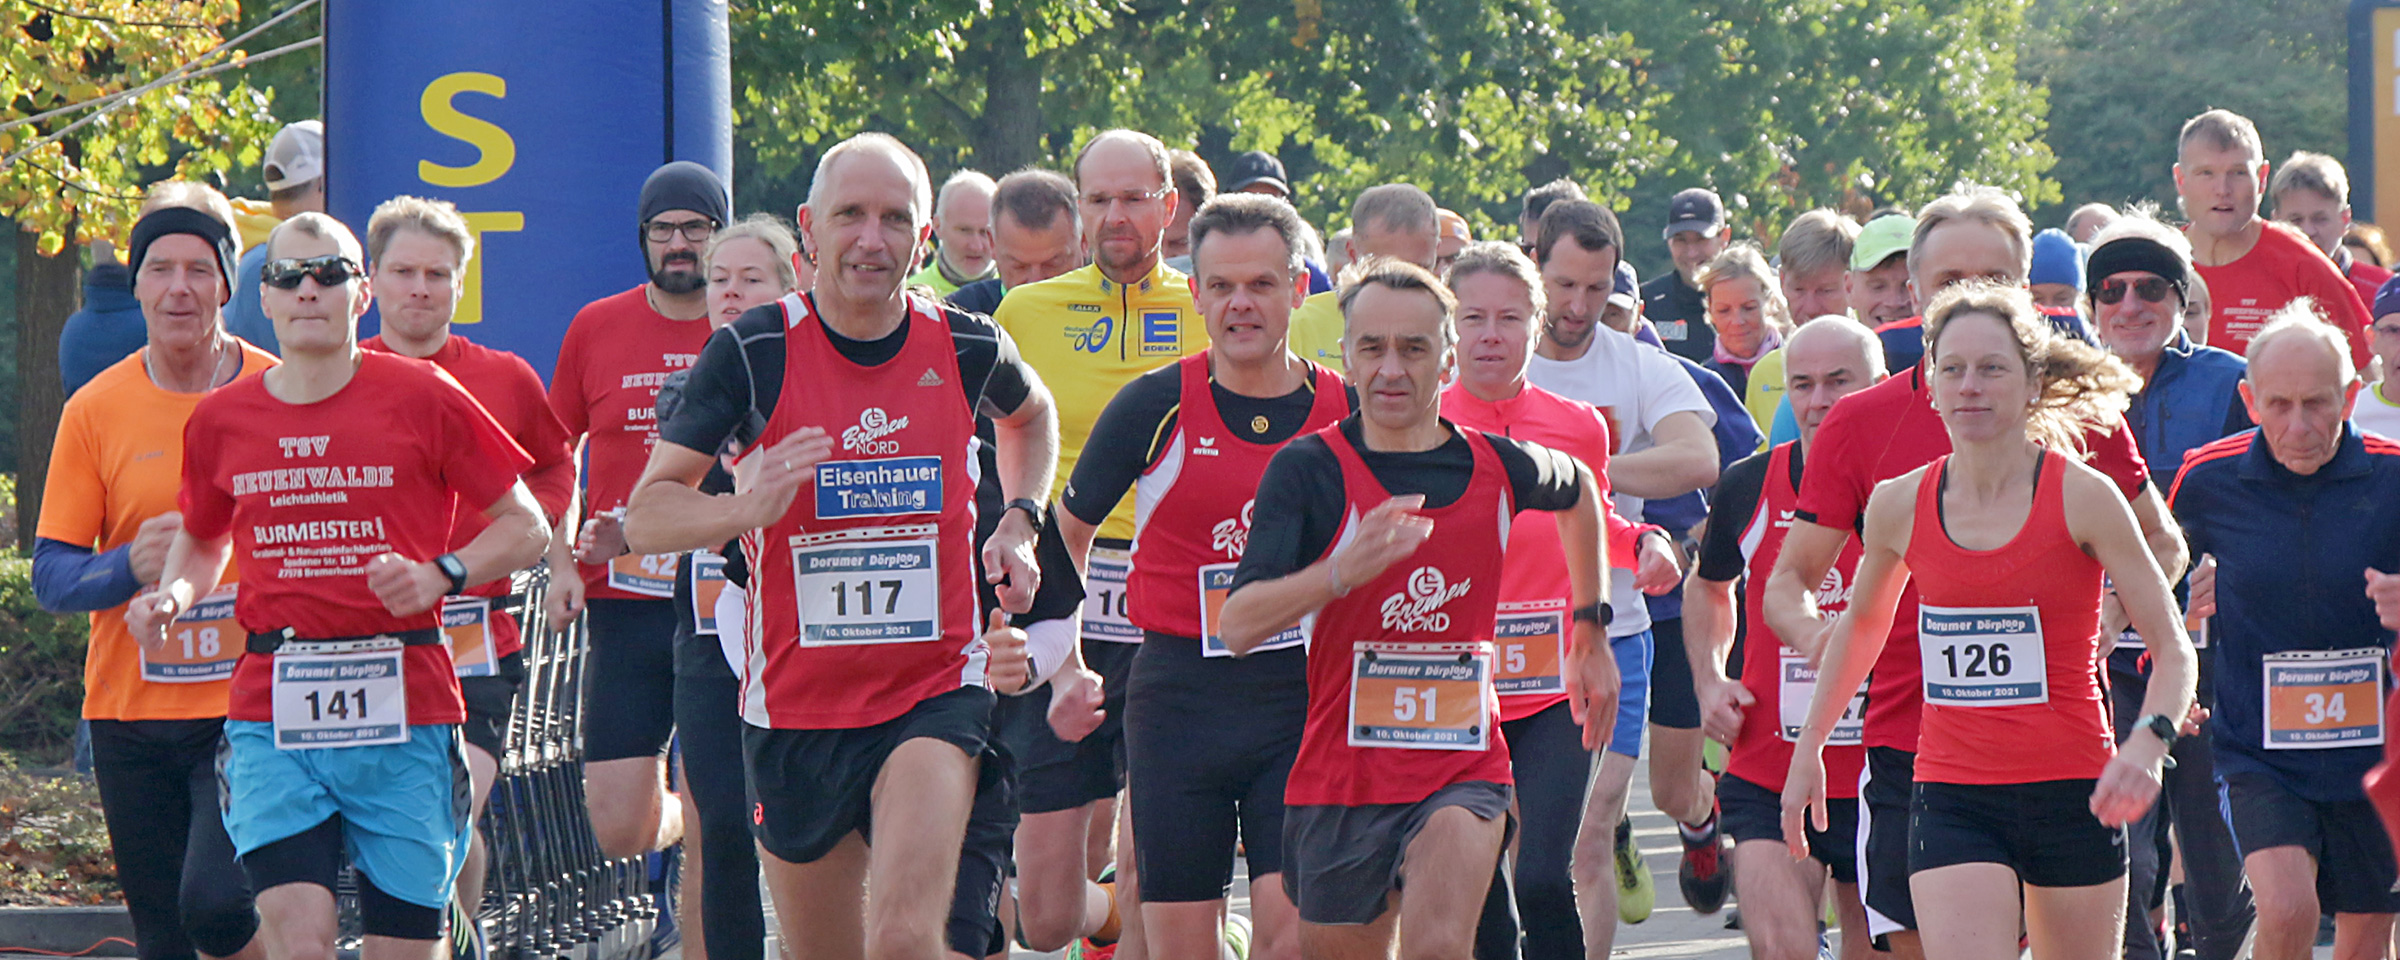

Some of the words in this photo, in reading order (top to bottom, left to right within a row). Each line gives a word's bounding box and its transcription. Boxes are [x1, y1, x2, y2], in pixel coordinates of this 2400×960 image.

[663, 353, 697, 367] TSV
[842, 416, 909, 450] Bremen
[279, 435, 330, 458] TSV
[856, 441, 899, 455] NORD
[232, 466, 394, 496] NEUENWALDE
[820, 466, 938, 487] Eisenhauer
[270, 491, 348, 507] Leichtathletik
[838, 488, 926, 509] Training
[340, 555, 358, 565] 126
[641, 553, 677, 577] 42
[810, 556, 864, 569] Dorumer
[869, 553, 921, 569] Dörploop
[304, 566, 365, 578] Bremerhaven
[832, 580, 902, 616] 117
[1381, 578, 1471, 629] Bremen
[1395, 612, 1451, 633] NORD
[1509, 622, 1550, 635] Dörploop
[1926, 618, 1972, 631] Dorumer
[1977, 619, 2026, 633] Dörploop
[825, 628, 839, 637] 10.
[842, 627, 883, 636] Oktober
[886, 626, 911, 635] 2021
[178, 627, 220, 660] 18
[1942, 643, 2012, 678] 126
[178, 664, 213, 676] Oktober
[286, 665, 335, 679] Dorumer
[340, 663, 388, 679] Dörploop
[1368, 662, 1420, 675] Dorumer
[1425, 665, 1473, 680] Dörploop
[2278, 671, 2325, 683] Dorumer
[2329, 669, 2370, 683] Dörploop
[1521, 680, 1541, 688] 2021
[1942, 688, 1955, 697] 10.
[1955, 688, 1992, 697] Oktober
[1995, 687, 2019, 696] 2021
[305, 688, 367, 721] 141
[1393, 687, 1437, 722] 51
[2304, 692, 2346, 724] 34
[317, 730, 354, 740] Oktober
[356, 728, 380, 738] 2021
[1376, 730, 1390, 740] 10.
[1393, 730, 1431, 740] Oktober
[1434, 731, 1458, 741] 2021
[2305, 731, 2339, 740] Oktober
[2341, 729, 2361, 738] 2021
